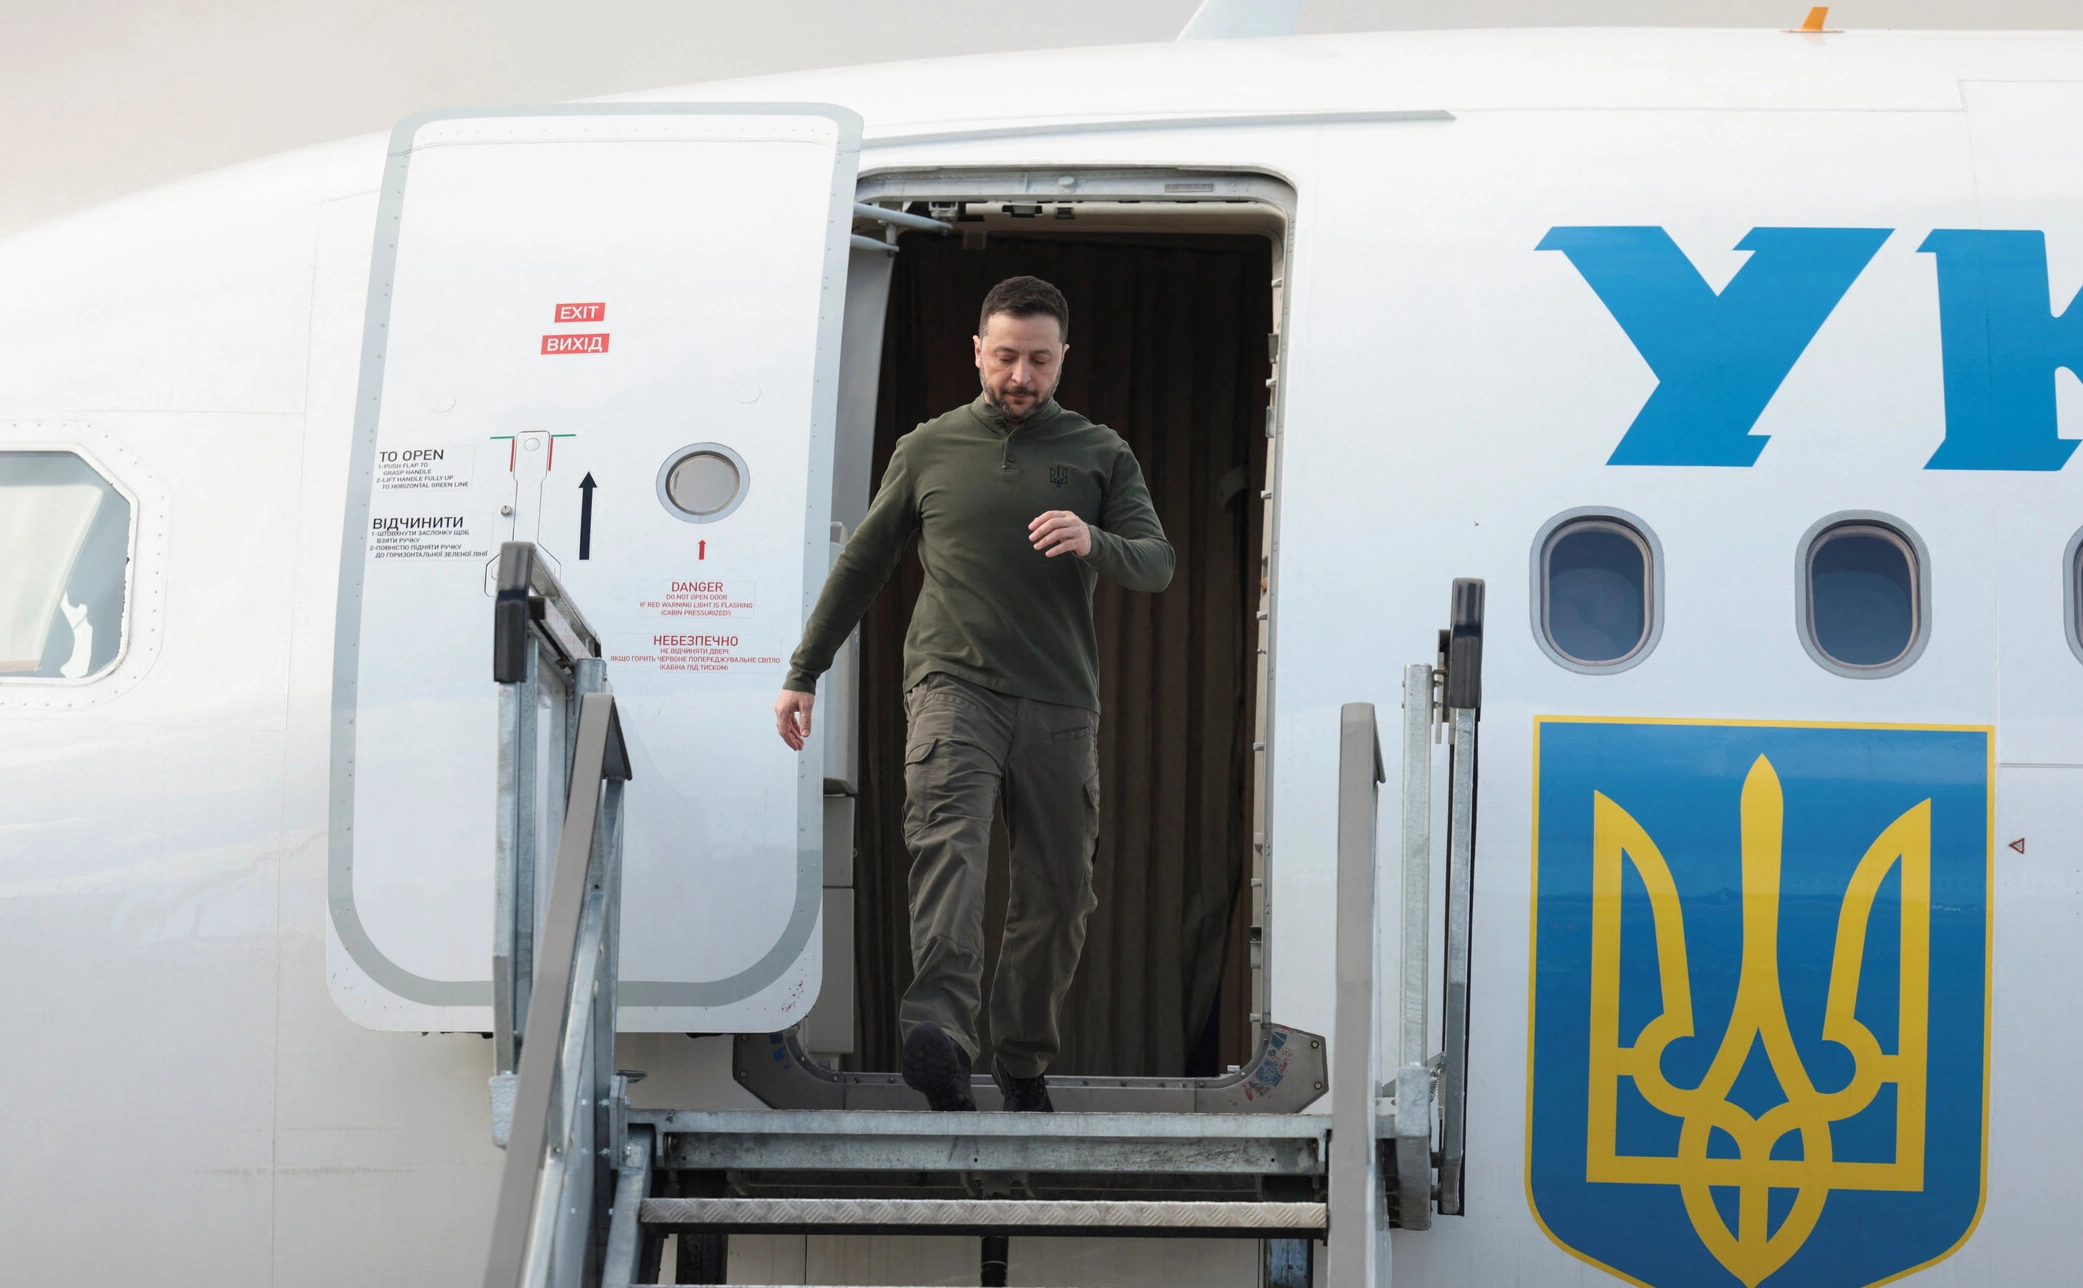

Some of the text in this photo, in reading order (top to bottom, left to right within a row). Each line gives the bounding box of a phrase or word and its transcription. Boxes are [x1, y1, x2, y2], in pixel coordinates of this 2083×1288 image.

[560, 305, 600, 320] EXIT
[547, 337, 603, 352] ВИХІД
[379, 449, 444, 462] TO OPEN
[372, 516, 464, 531] ВІДЧИНИТИ
[671, 582, 723, 592] DANGER
[654, 635, 738, 647] НЕБЕЗПЕЧНО
